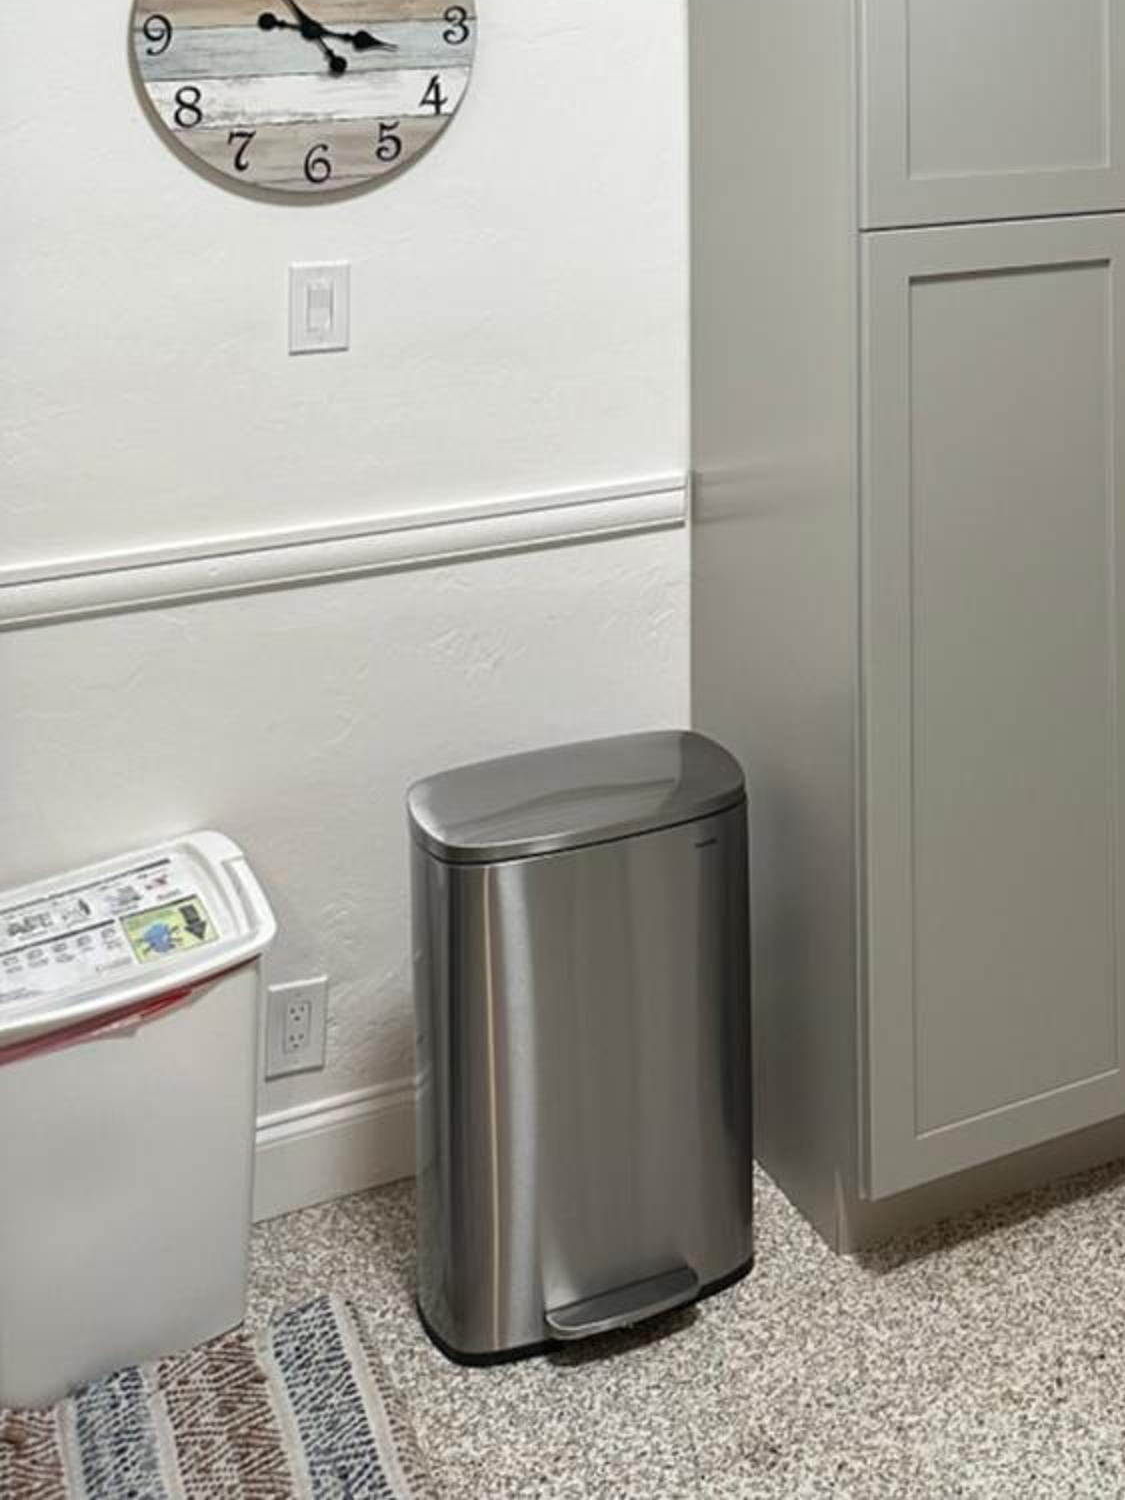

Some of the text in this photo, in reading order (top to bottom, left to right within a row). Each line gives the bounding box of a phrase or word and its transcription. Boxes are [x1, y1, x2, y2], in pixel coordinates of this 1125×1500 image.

[141, 13, 173, 56] 9
[442, 5, 470, 45] 3
[174, 86, 203, 128] 8
[420, 75, 448, 116] 4
[228, 131, 256, 172] 7
[375, 121, 402, 162] 5
[303, 143, 332, 184] 6
